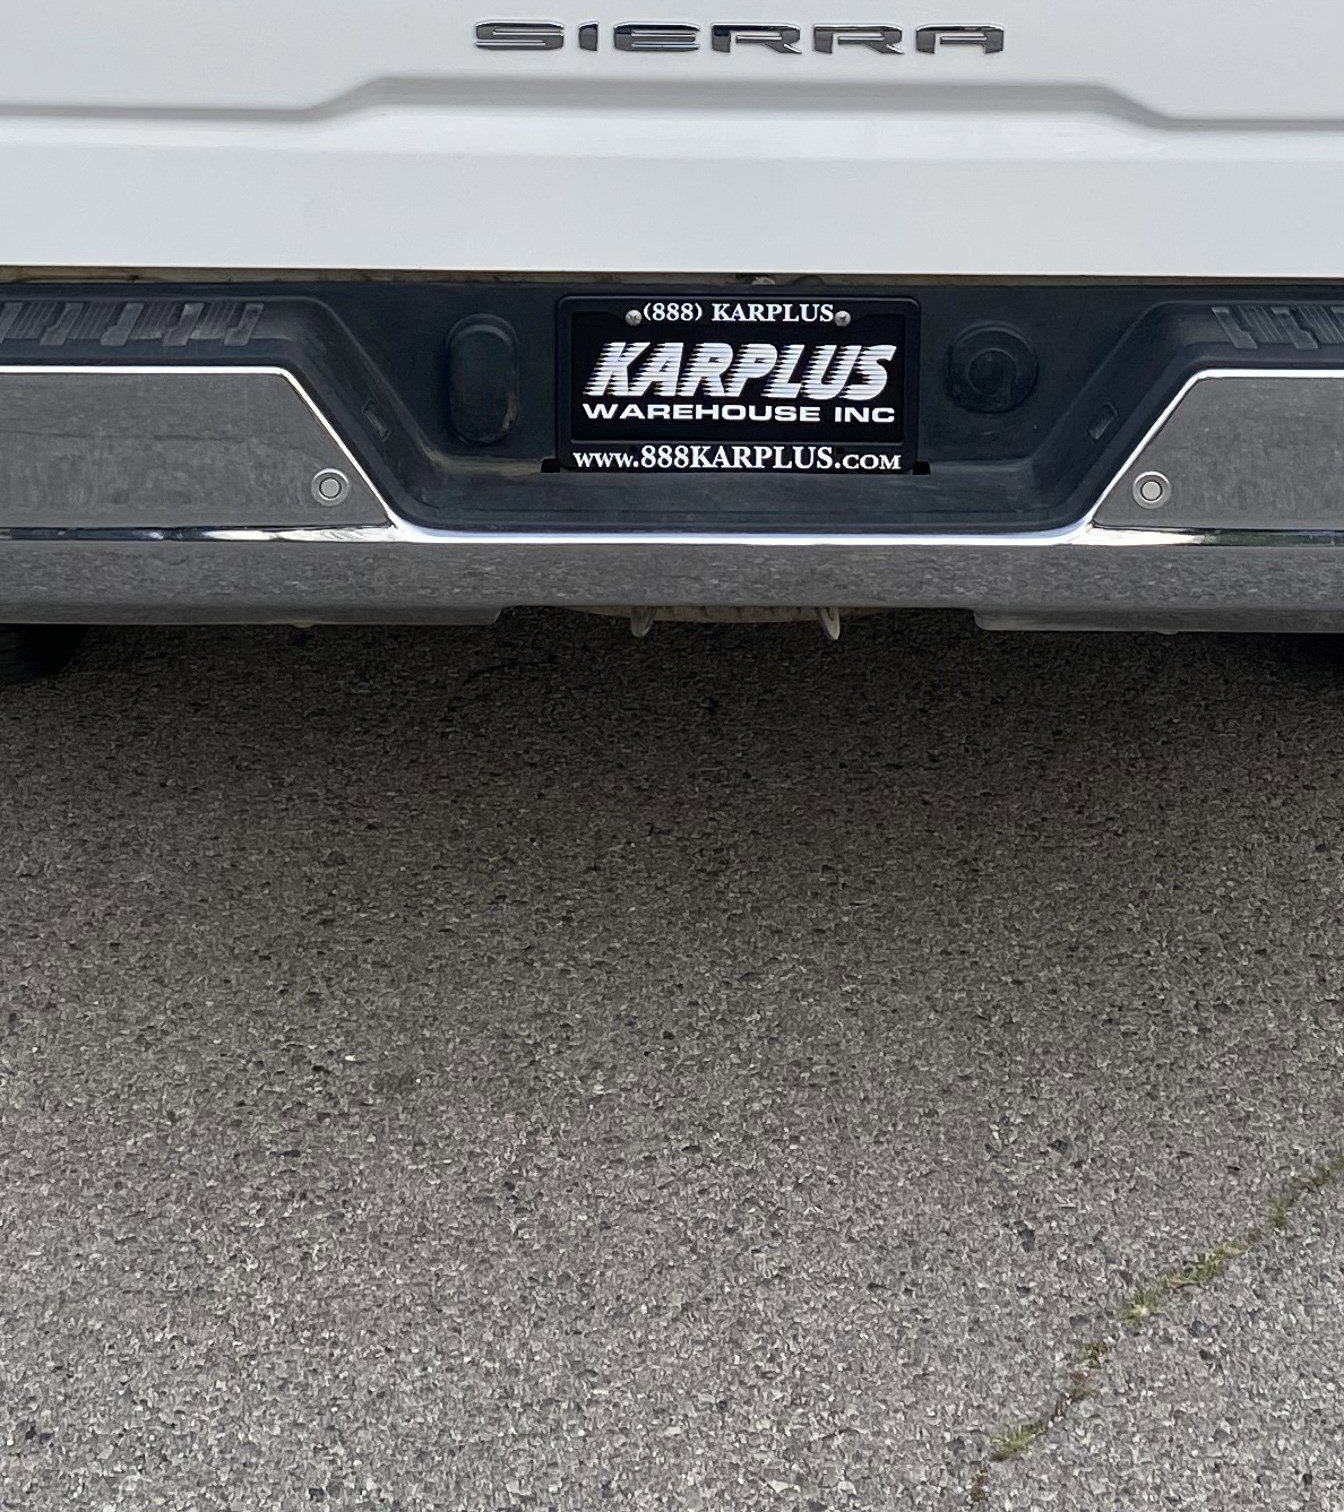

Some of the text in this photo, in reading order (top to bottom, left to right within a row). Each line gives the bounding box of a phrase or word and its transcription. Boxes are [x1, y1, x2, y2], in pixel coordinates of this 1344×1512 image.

[474, 20, 1005, 55] SIERRA
[643, 302, 834, 322] (888) KARPLUS
[582, 341, 897, 401] KARPLUS
[582, 403, 896, 424] WAREHOUSE INC
